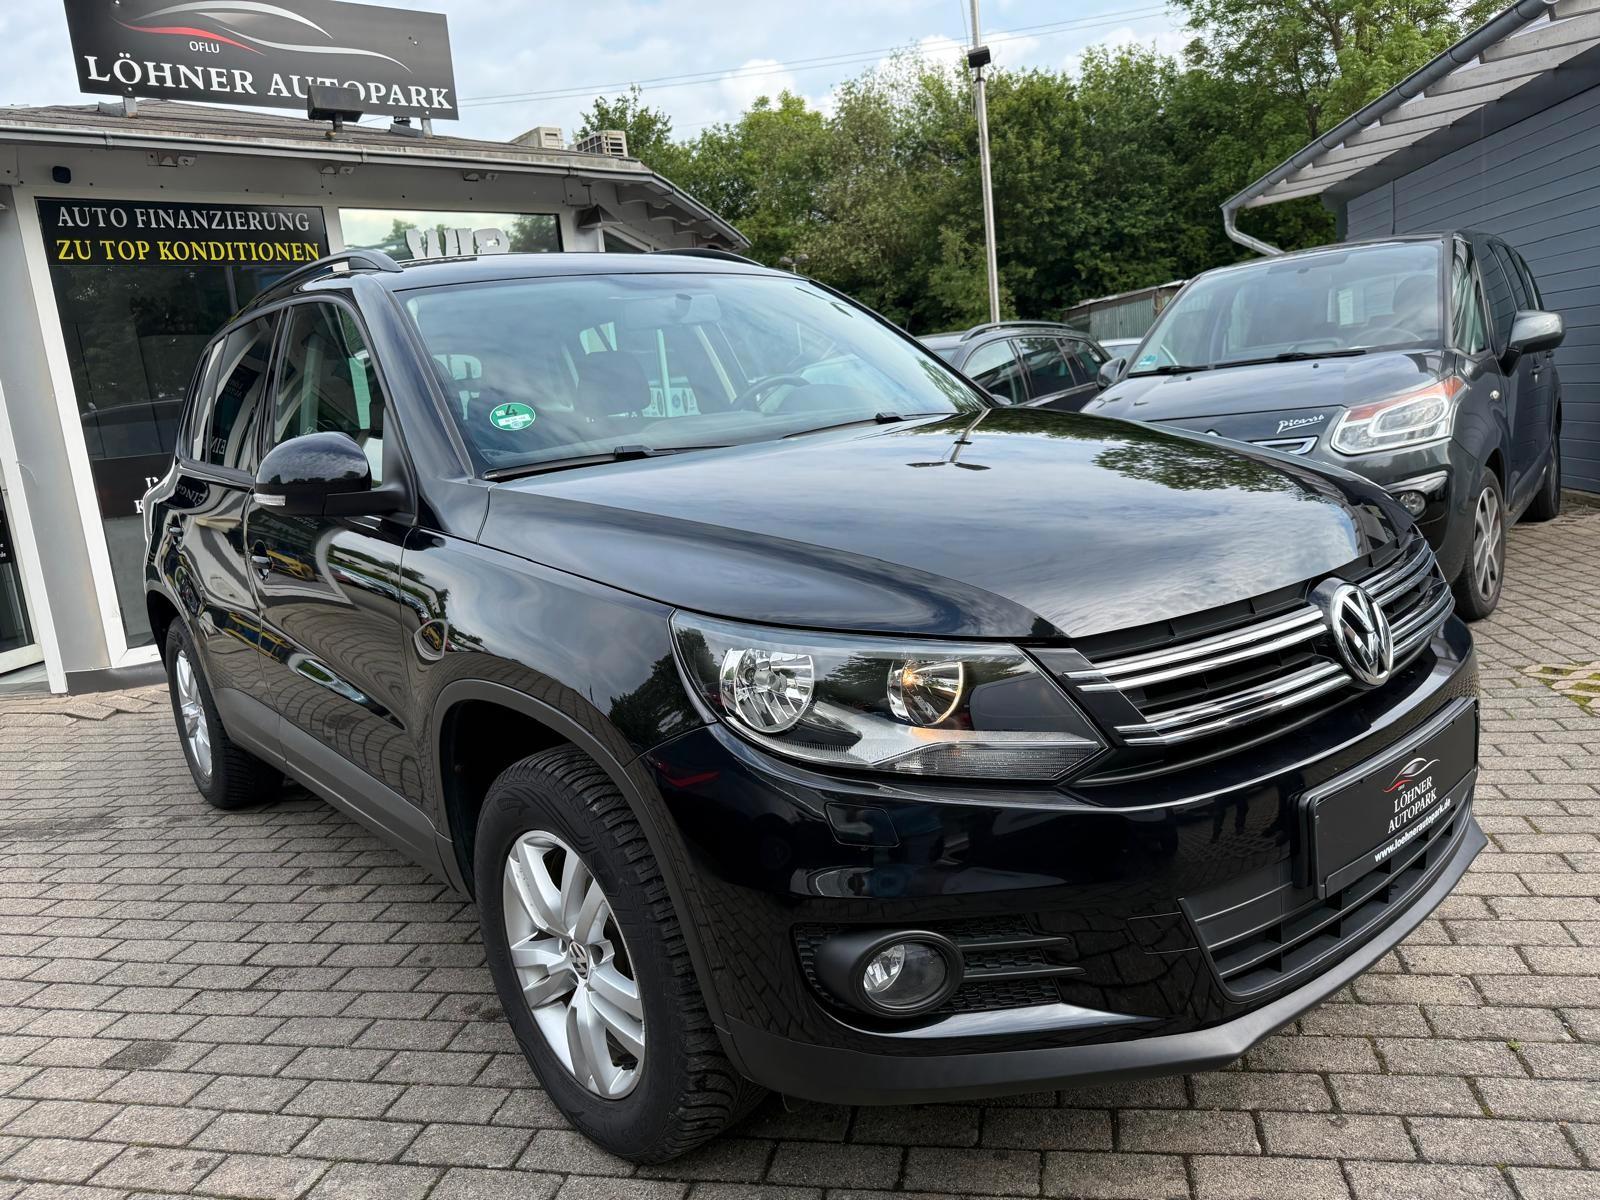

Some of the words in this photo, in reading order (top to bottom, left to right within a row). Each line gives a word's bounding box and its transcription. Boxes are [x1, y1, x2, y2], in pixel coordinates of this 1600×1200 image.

[189, 40, 220, 54] OFLU
[83, 52, 257, 95] LÖHNER
[57, 206, 128, 228] AUTO
[136, 208, 310, 231] FINANZIERUNG
[56, 239, 91, 260] ZU
[100, 240, 150, 260] TOP
[157, 240, 320, 261] KONDITIONEN
[1387, 787, 1438, 834] AUTOPARK
[1393, 775, 1433, 813] LÖHNER
[1374, 797, 1451, 863] www.loehnerautopark.de
